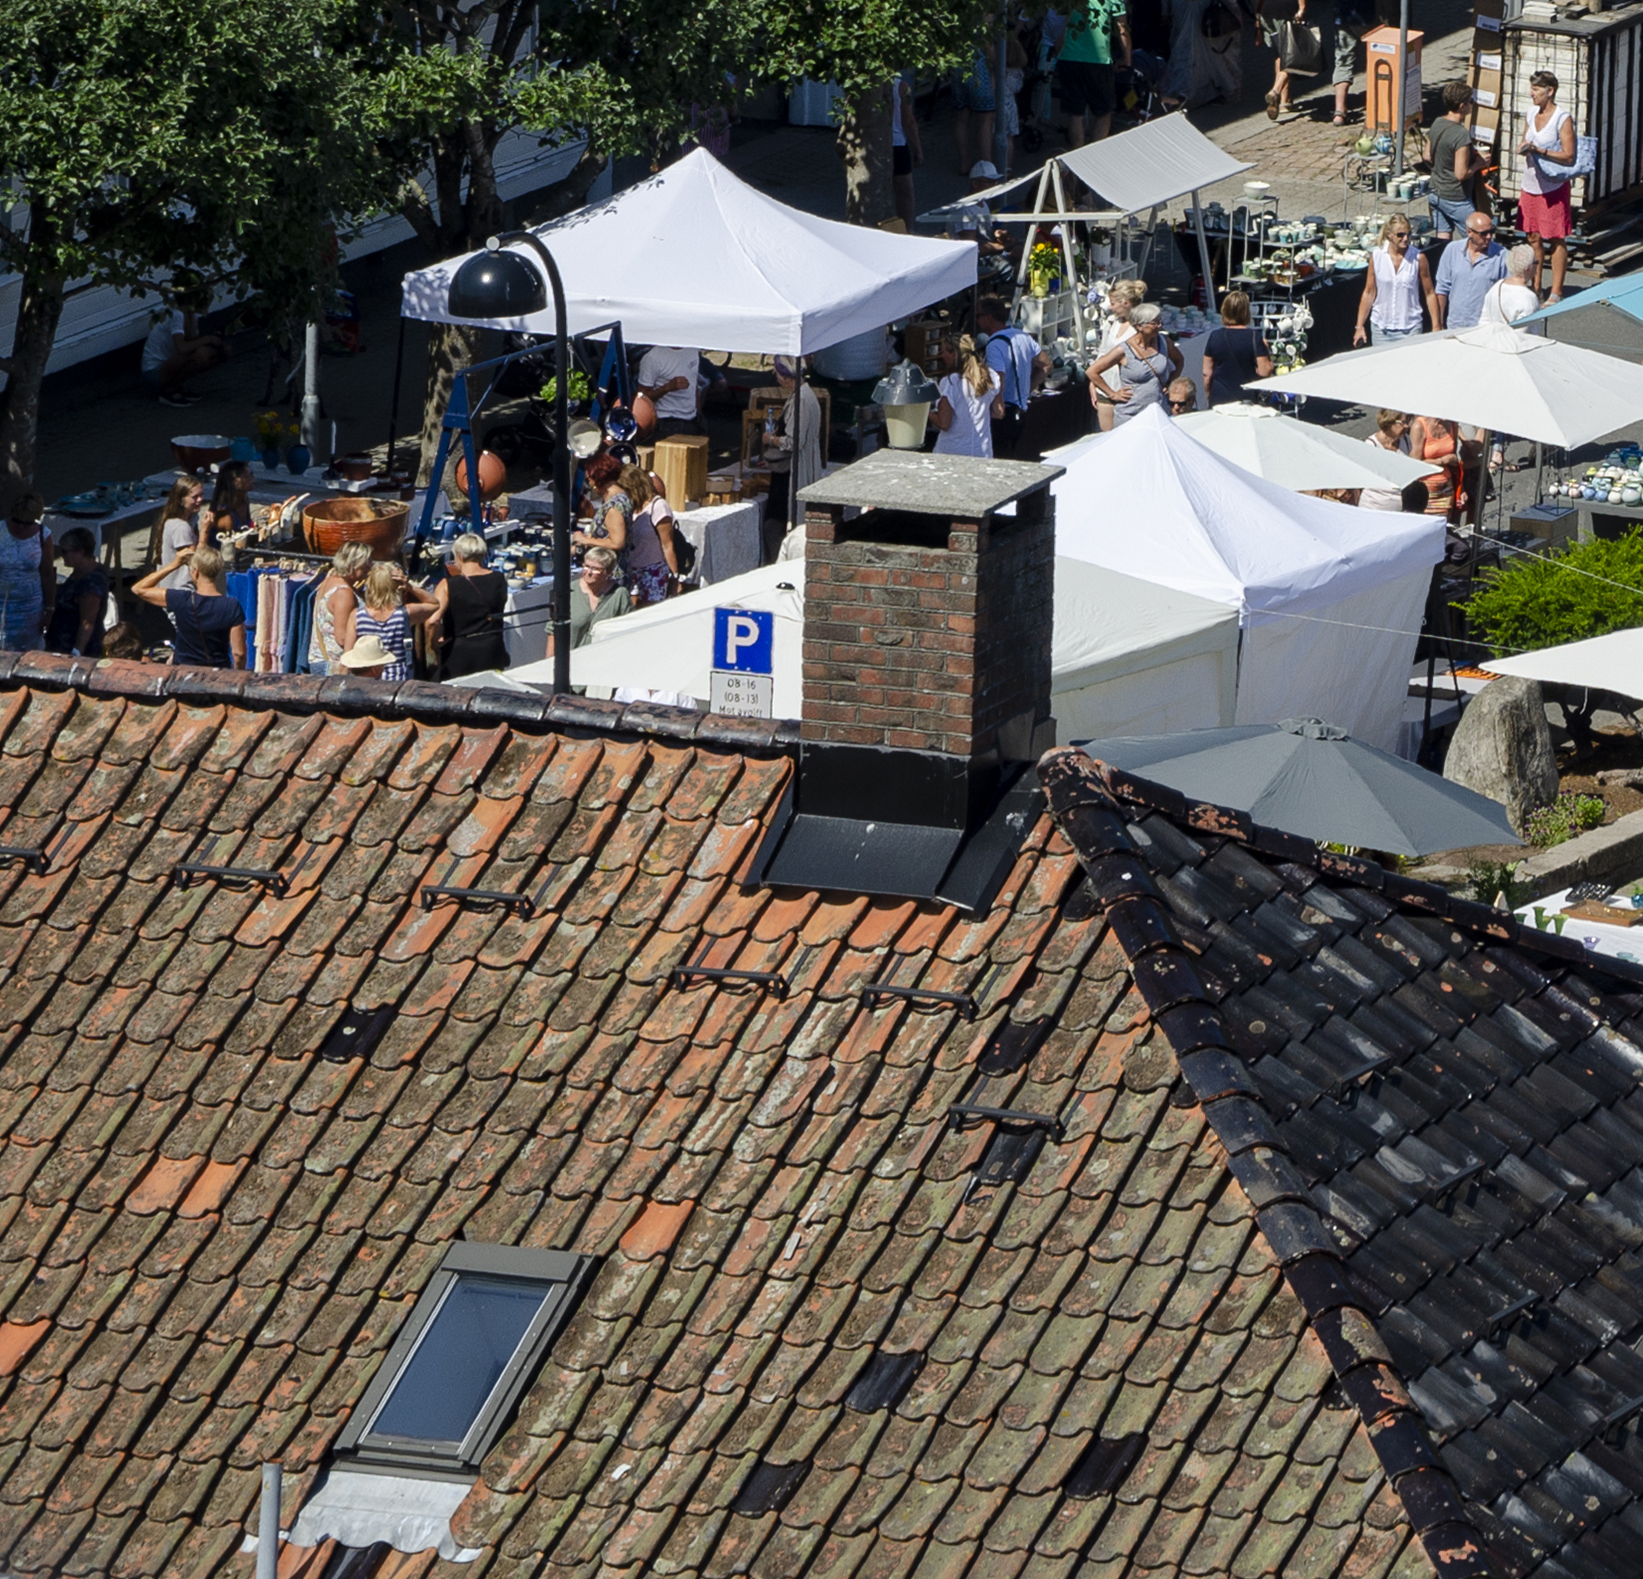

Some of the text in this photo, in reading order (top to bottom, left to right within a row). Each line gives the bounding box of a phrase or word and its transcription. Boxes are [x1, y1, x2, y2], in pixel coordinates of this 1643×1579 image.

[726, 615, 760, 664] P
[726, 678, 757, 690] 08-16
[723, 692, 759, 705] (08-13)
[719, 706, 736, 715] Mot
